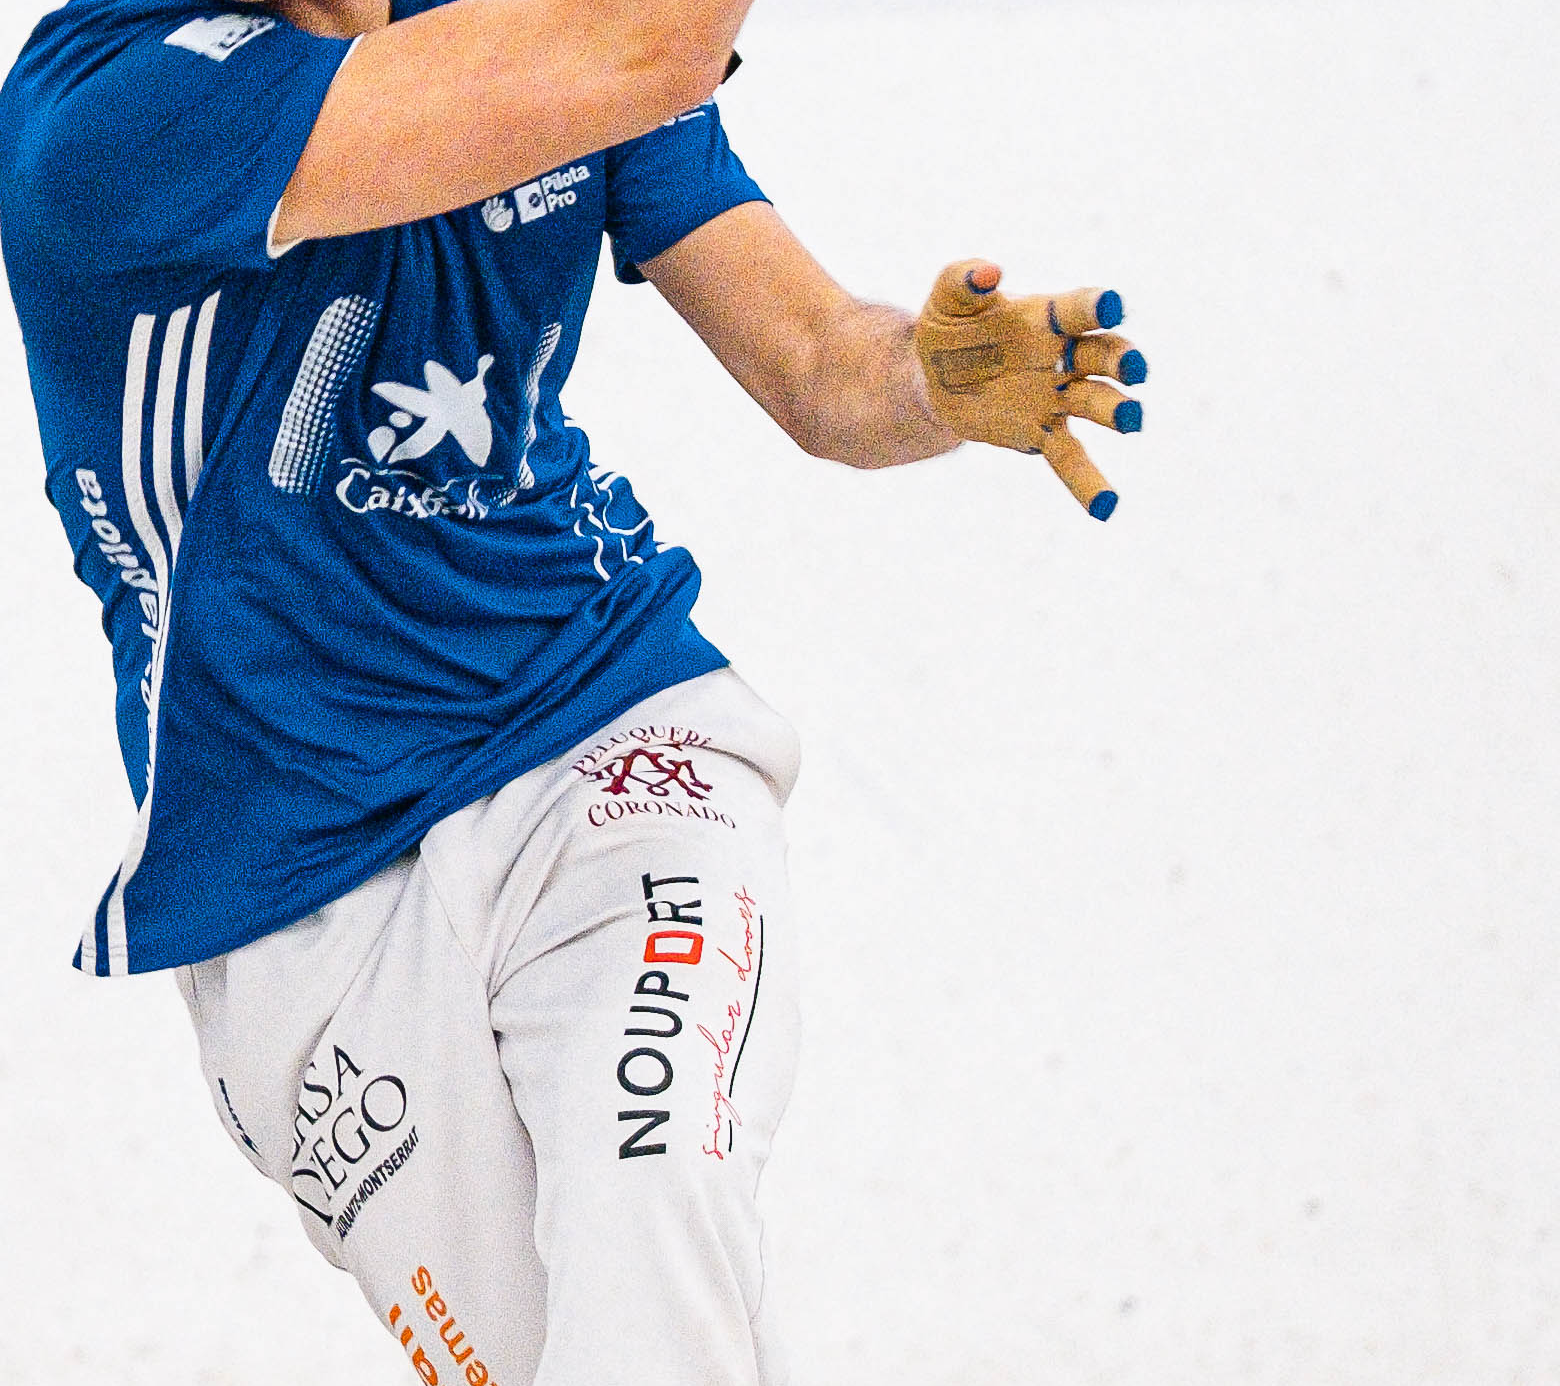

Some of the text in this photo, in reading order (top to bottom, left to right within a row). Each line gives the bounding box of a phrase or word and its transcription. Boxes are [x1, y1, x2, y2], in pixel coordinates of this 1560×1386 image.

[541, 165, 591, 195] Pilota
[545, 190, 577, 213] Pro
[587, 799, 737, 830] CORONADO
